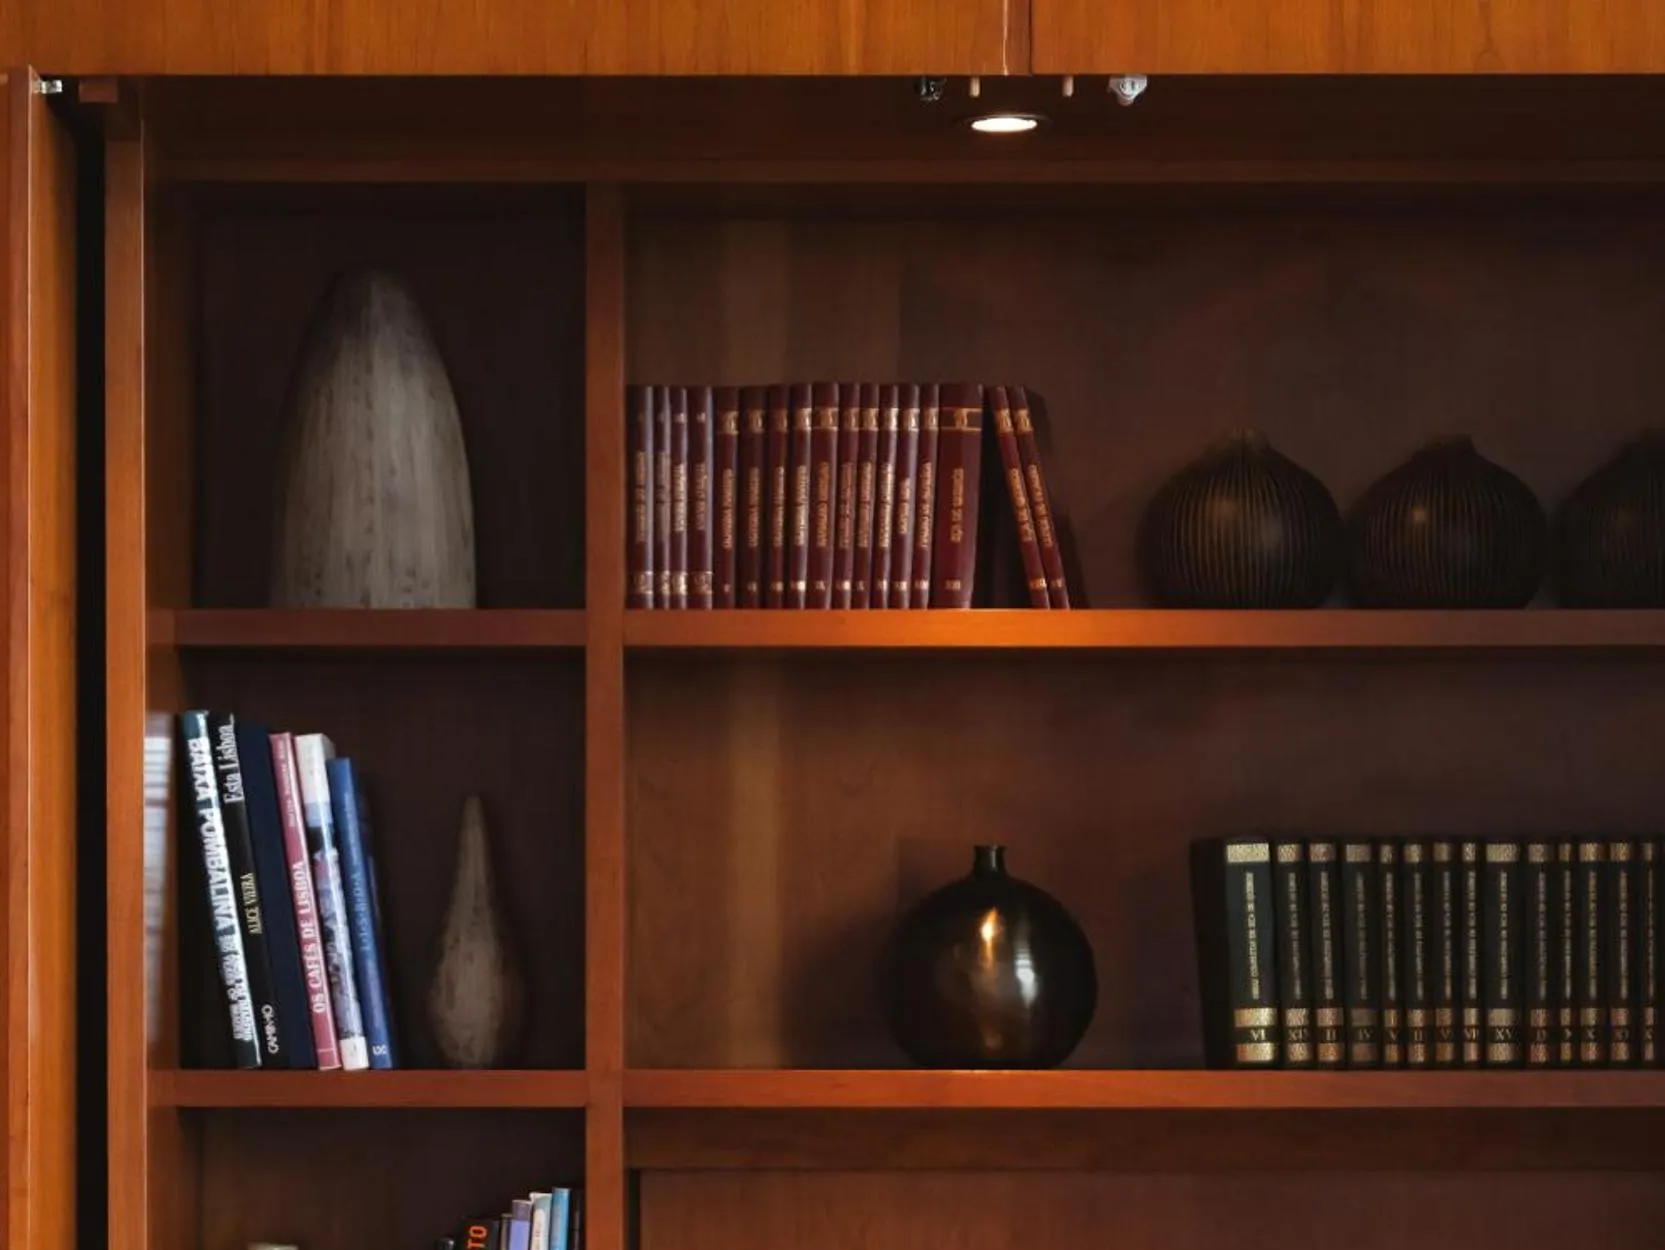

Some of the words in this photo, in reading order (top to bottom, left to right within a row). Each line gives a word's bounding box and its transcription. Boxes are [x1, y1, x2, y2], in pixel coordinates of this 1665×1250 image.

[187, 736, 216, 801] BAIXA
[220, 772, 244, 803] Esta
[198, 807, 238, 936] POMBALINA
[290, 859, 311, 914] LISBOA
[245, 905, 262, 935] ALICE
[299, 918, 315, 938] DE
[310, 992, 325, 1013] OS
